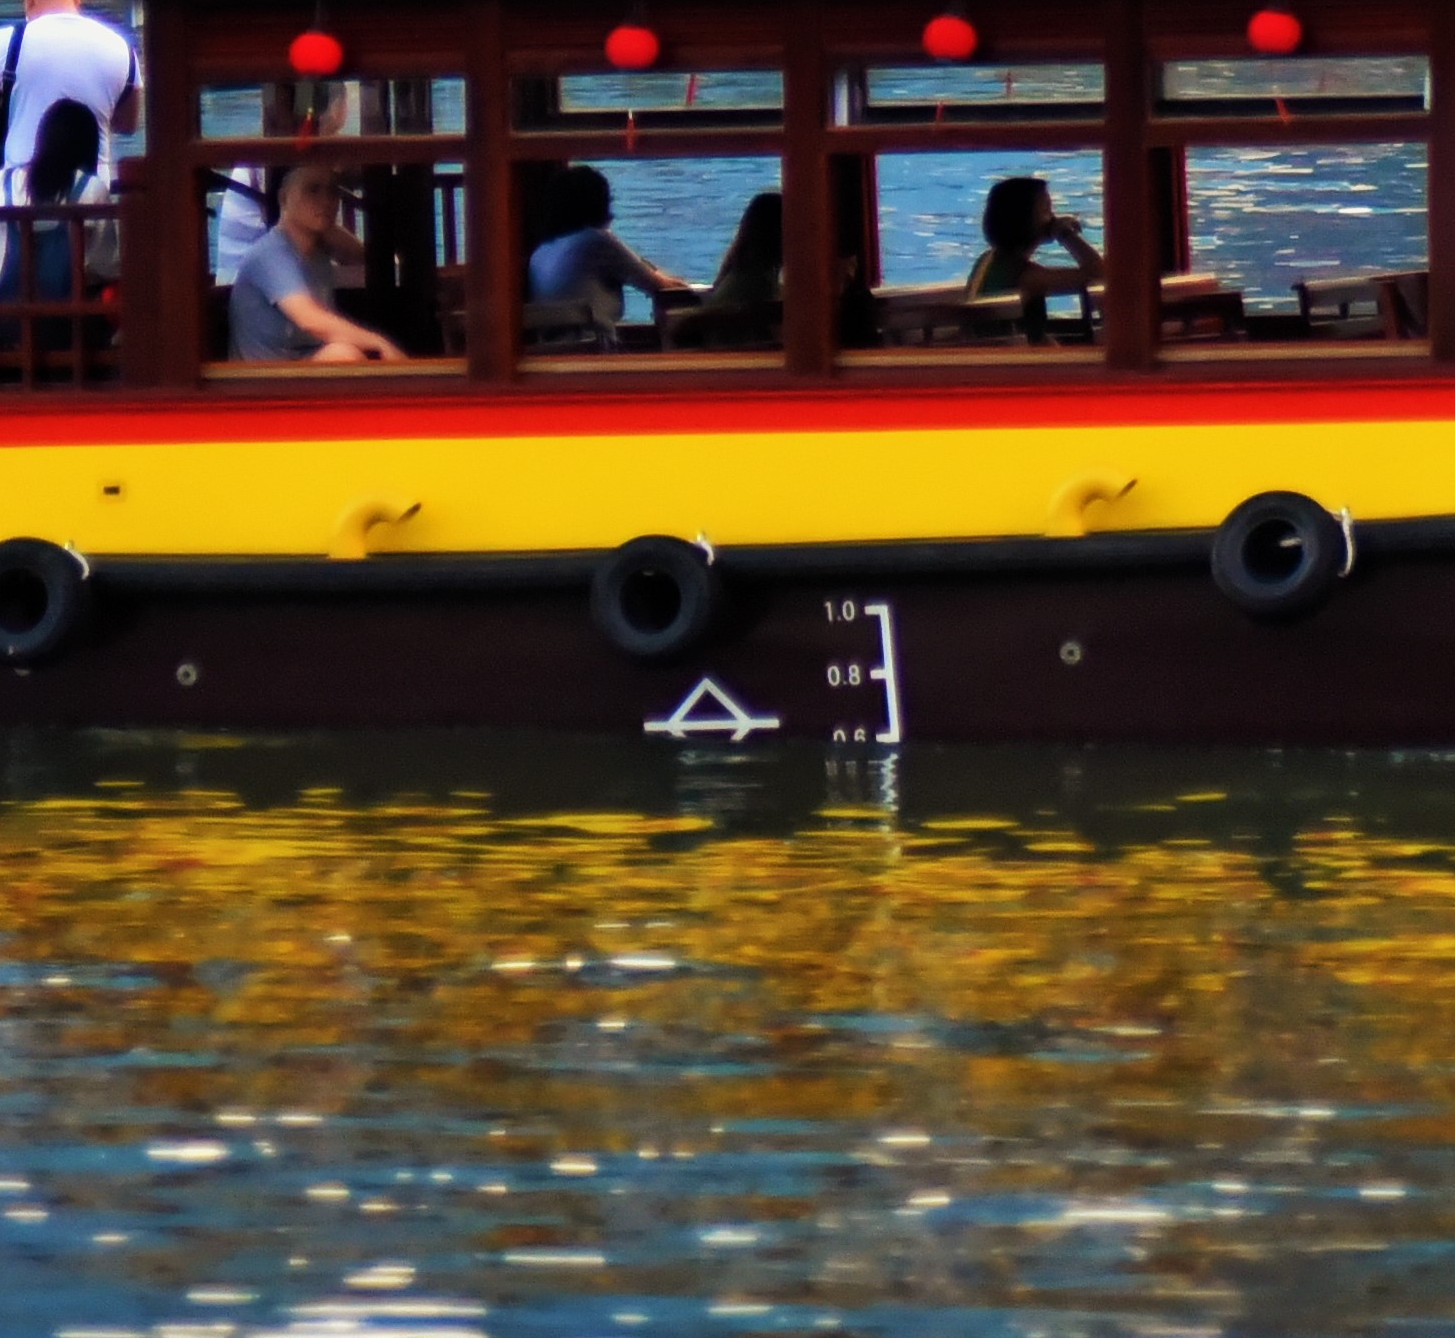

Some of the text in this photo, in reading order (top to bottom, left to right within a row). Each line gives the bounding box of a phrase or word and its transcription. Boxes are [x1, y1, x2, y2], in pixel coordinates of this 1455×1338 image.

[824, 600, 855, 622] 1.0
[827, 664, 861, 686] 0.8
[833, 728, 866, 743] 06
